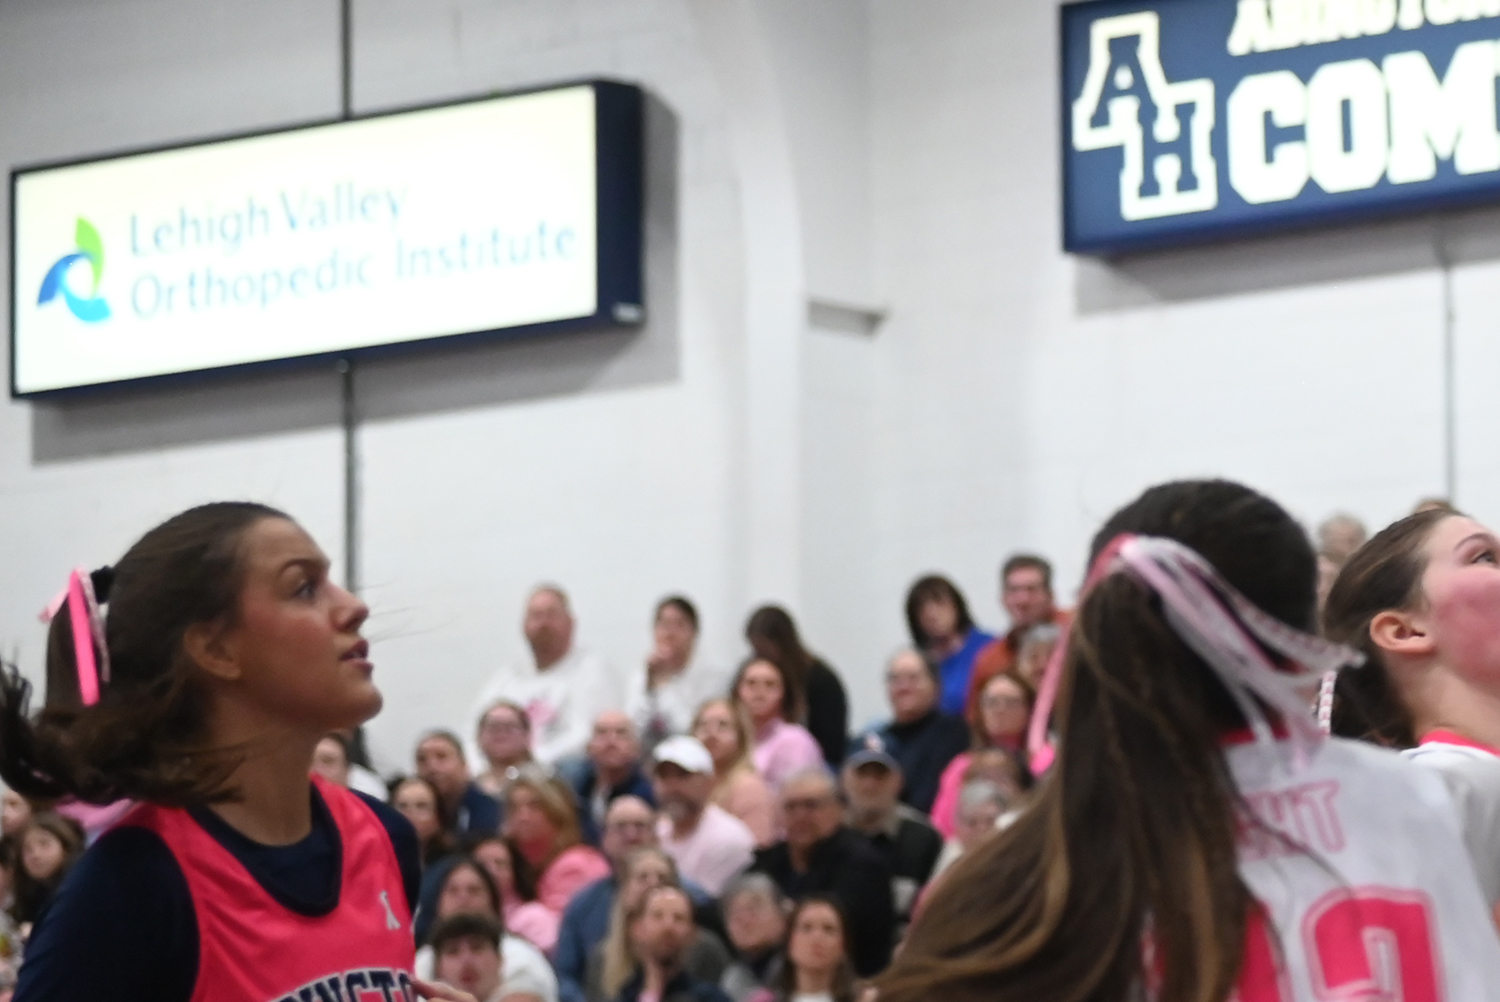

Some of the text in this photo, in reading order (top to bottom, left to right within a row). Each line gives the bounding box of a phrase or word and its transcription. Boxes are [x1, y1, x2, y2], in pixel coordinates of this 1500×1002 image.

[129, 180, 409, 259] Lehigh Valley
[130, 217, 577, 319] Orthopedic Institute
